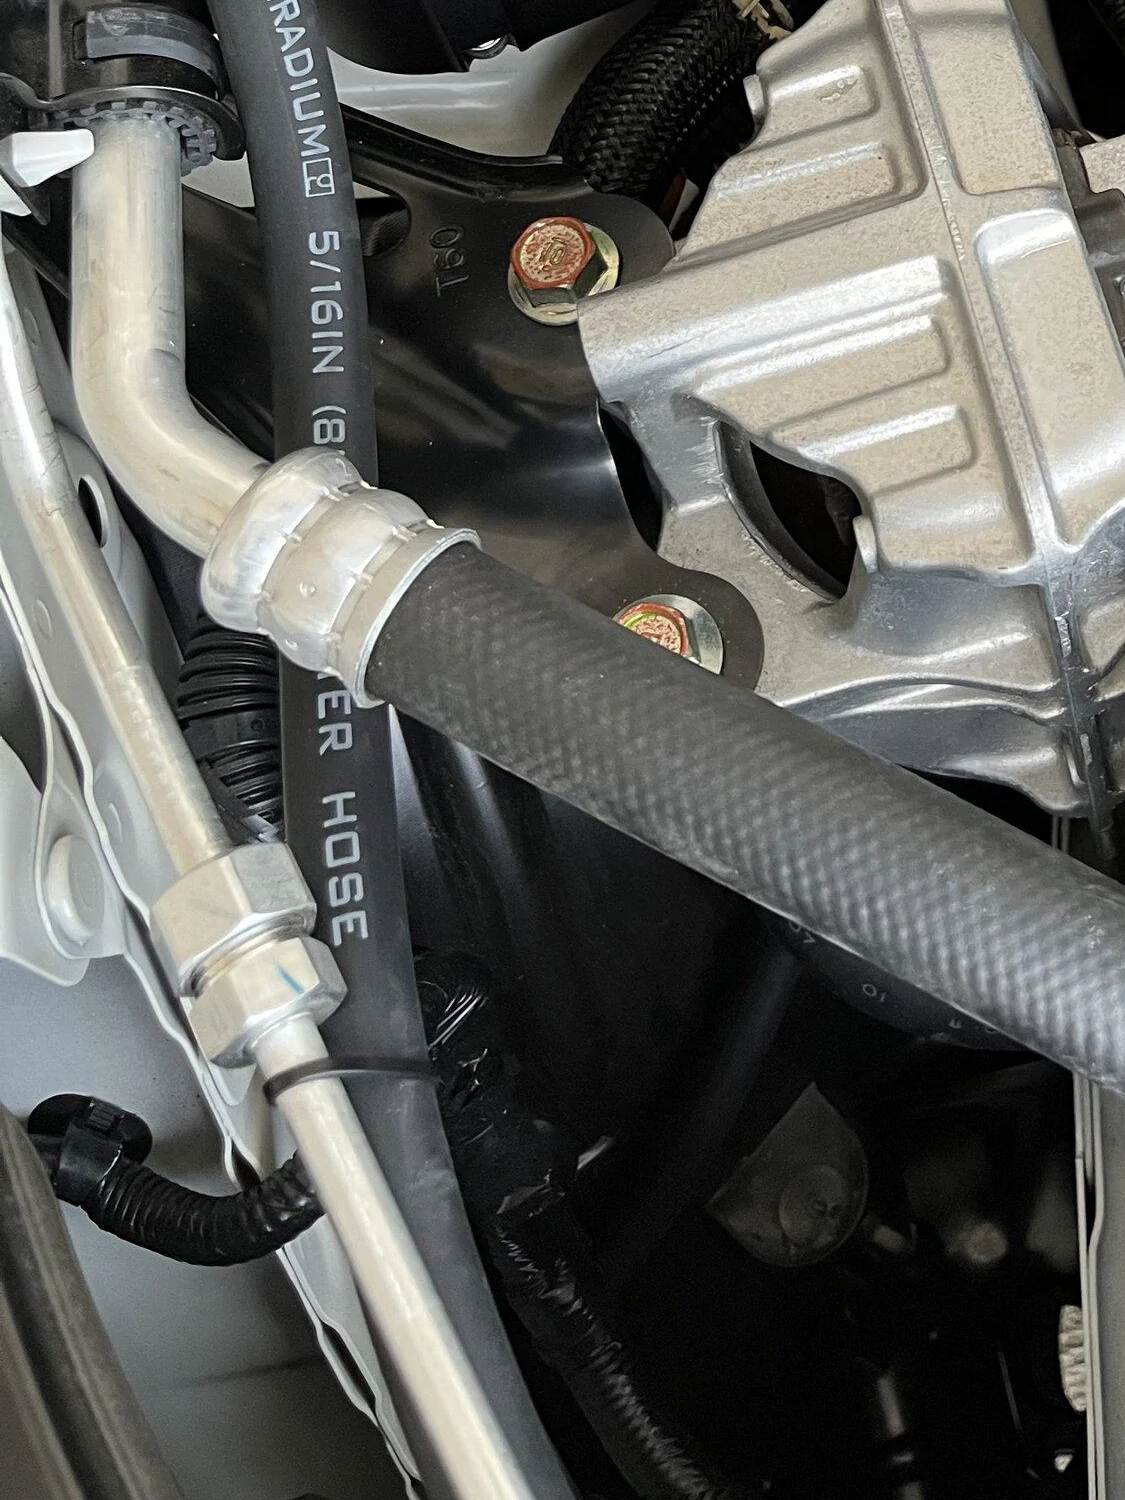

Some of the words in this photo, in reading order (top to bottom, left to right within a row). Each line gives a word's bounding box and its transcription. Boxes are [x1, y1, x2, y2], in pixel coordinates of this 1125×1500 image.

[308, 230, 344, 375] 5/16IN
[311, 405, 347, 456] (8
[322, 790, 368, 946] HOSE
